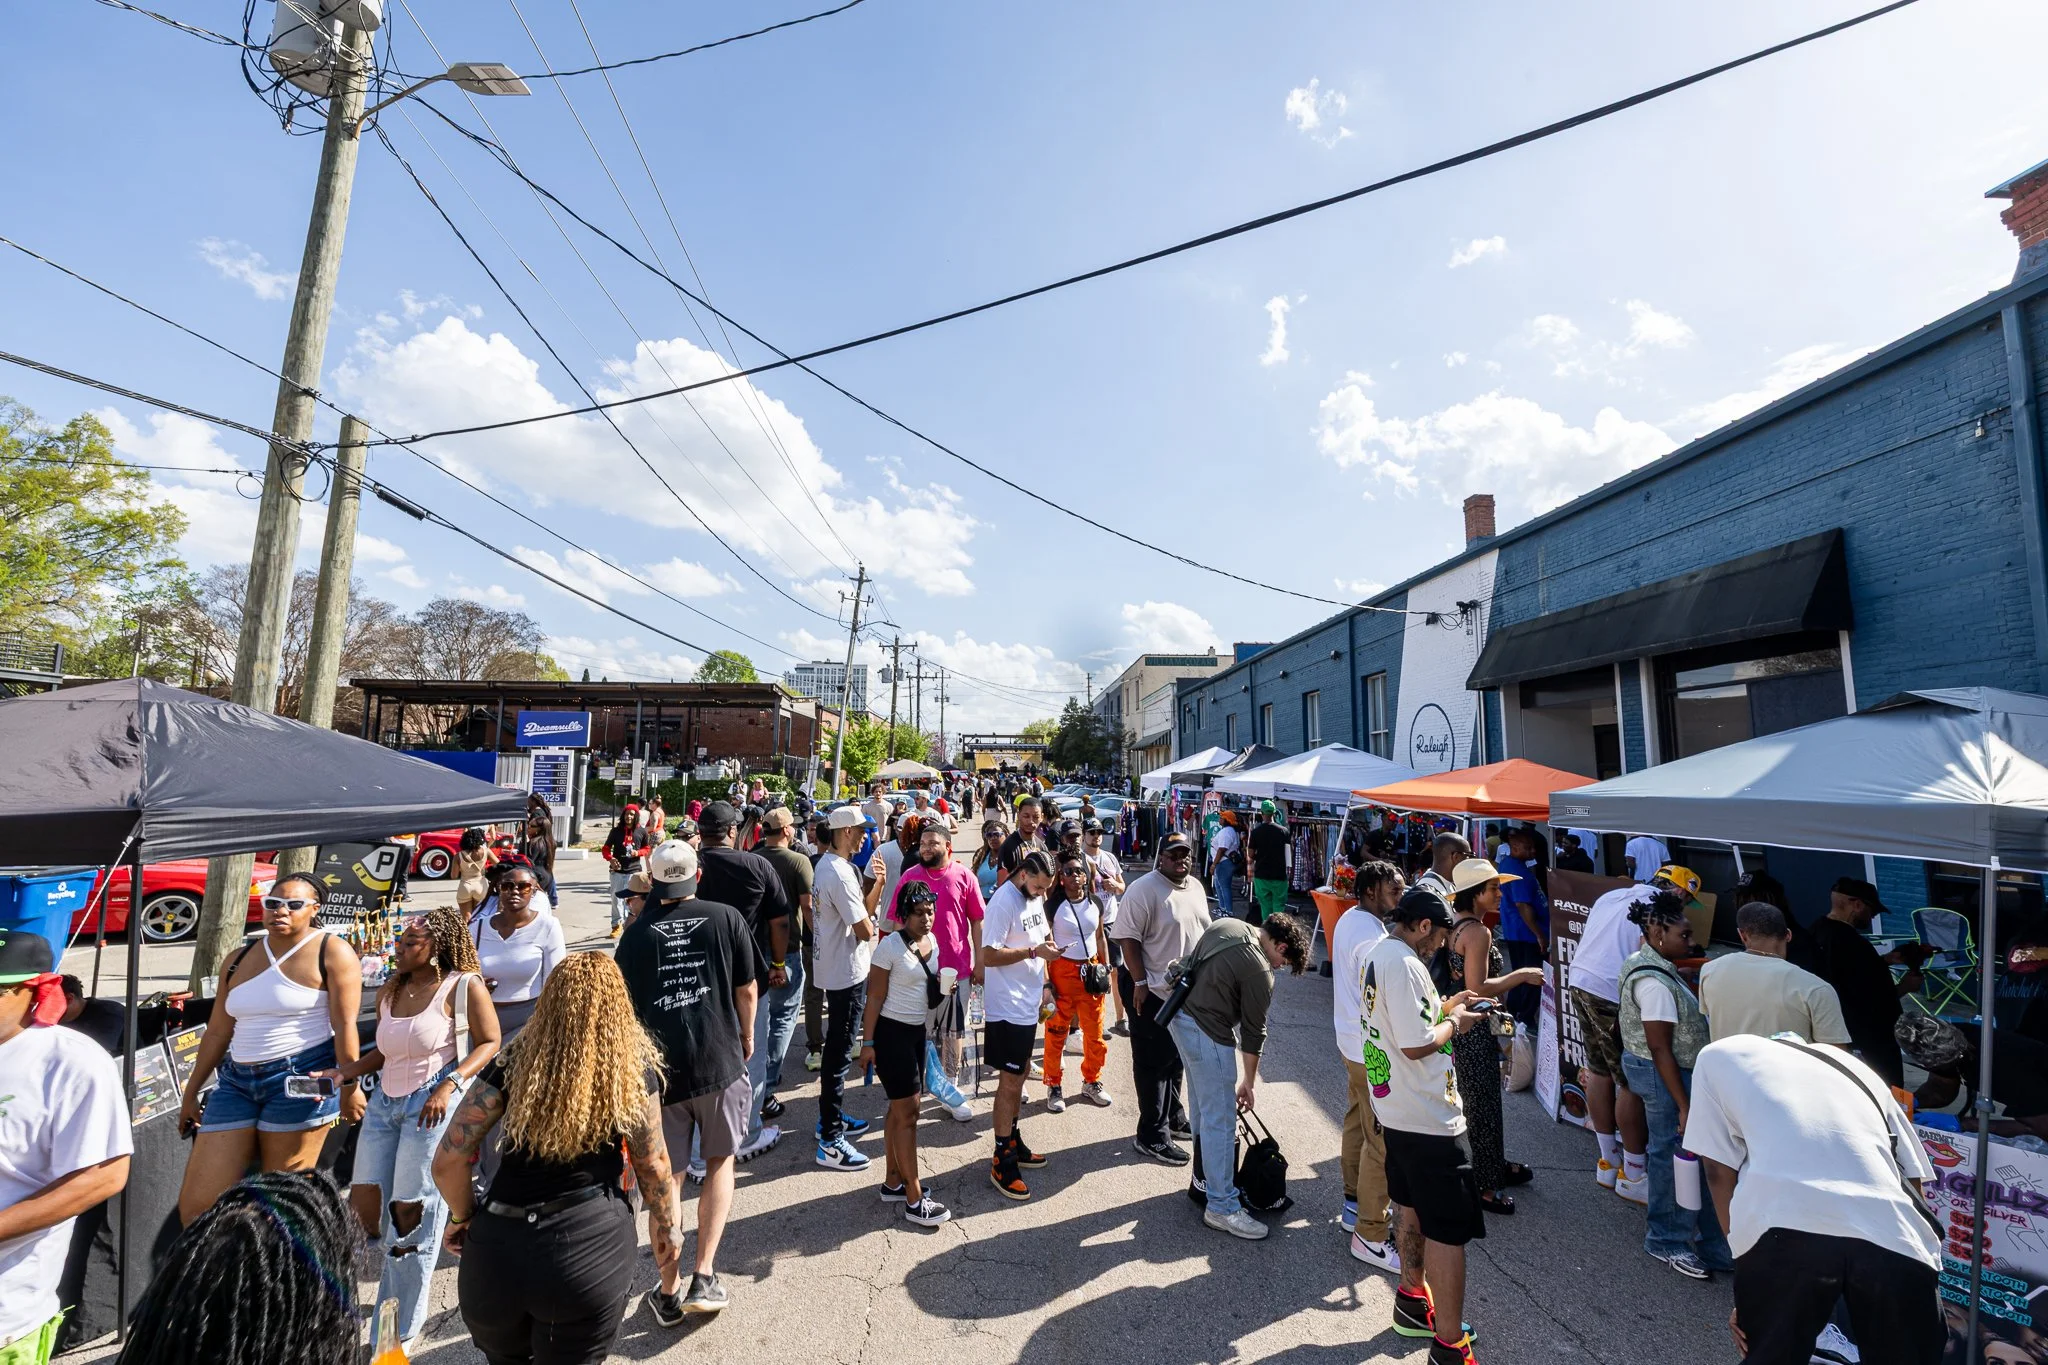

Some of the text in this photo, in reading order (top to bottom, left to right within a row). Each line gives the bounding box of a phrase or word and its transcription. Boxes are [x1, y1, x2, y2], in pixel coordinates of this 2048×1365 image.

[1416, 734, 1449, 761] Raleigh
[542, 794, 560, 802] 025
[375, 851, 395, 873] P
[47, 890, 76, 900] Recycling
[327, 893, 363, 905] IGHT &
[1553, 899, 1592, 914] RATC
[317, 915, 360, 924] ARKIN
[1568, 920, 1586, 934] @R
[1557, 936, 1579, 963] FR
[684, 976, 698, 984] BOY
[676, 990, 694, 1001] FALL
[1561, 1013, 1584, 1042] FR
[177, 1031, 196, 1045] NEW
[1564, 1039, 1588, 1068] FR
[1951, 1198, 1970, 1212] OR
[1984, 1207, 2028, 1228] SILVER
[1952, 1211, 1988, 1231] $10
[1951, 1227, 1991, 1249] $20
[1986, 1271, 2027, 1291] TOOTH
[1986, 1287, 2028, 1308] TOOTH
[1990, 1305, 2031, 1326] TOOTH
